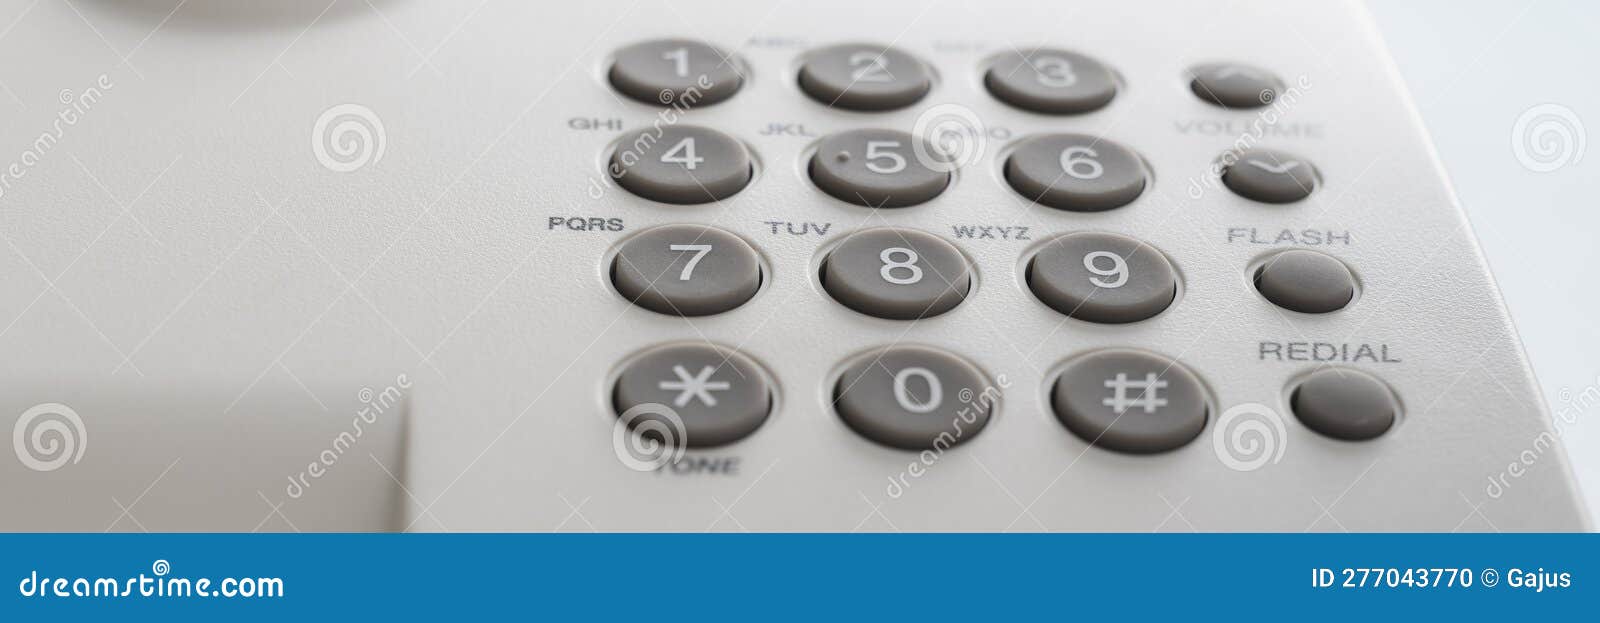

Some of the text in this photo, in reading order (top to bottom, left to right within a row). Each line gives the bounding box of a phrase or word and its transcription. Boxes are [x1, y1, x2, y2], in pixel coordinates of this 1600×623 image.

[663, 48, 688, 77] 1
[849, 53, 888, 82] 2
[1034, 56, 1077, 88] 3
[568, 117, 623, 130] GHI
[759, 122, 818, 137] JKL
[660, 136, 704, 170] 4
[865, 140, 907, 174] 5
[1059, 146, 1104, 179] 6
[548, 216, 625, 232] PQRS
[763, 221, 832, 237] TUV
[952, 224, 1032, 240] WXYZ
[1227, 227, 1351, 247] FLASH
[669, 243, 713, 281] 7
[879, 247, 924, 285] 8
[1083, 250, 1130, 289] 9
[1258, 341, 1402, 363] REDIAL
[893, 366, 943, 413] 0
[1102, 372, 1169, 414] #
